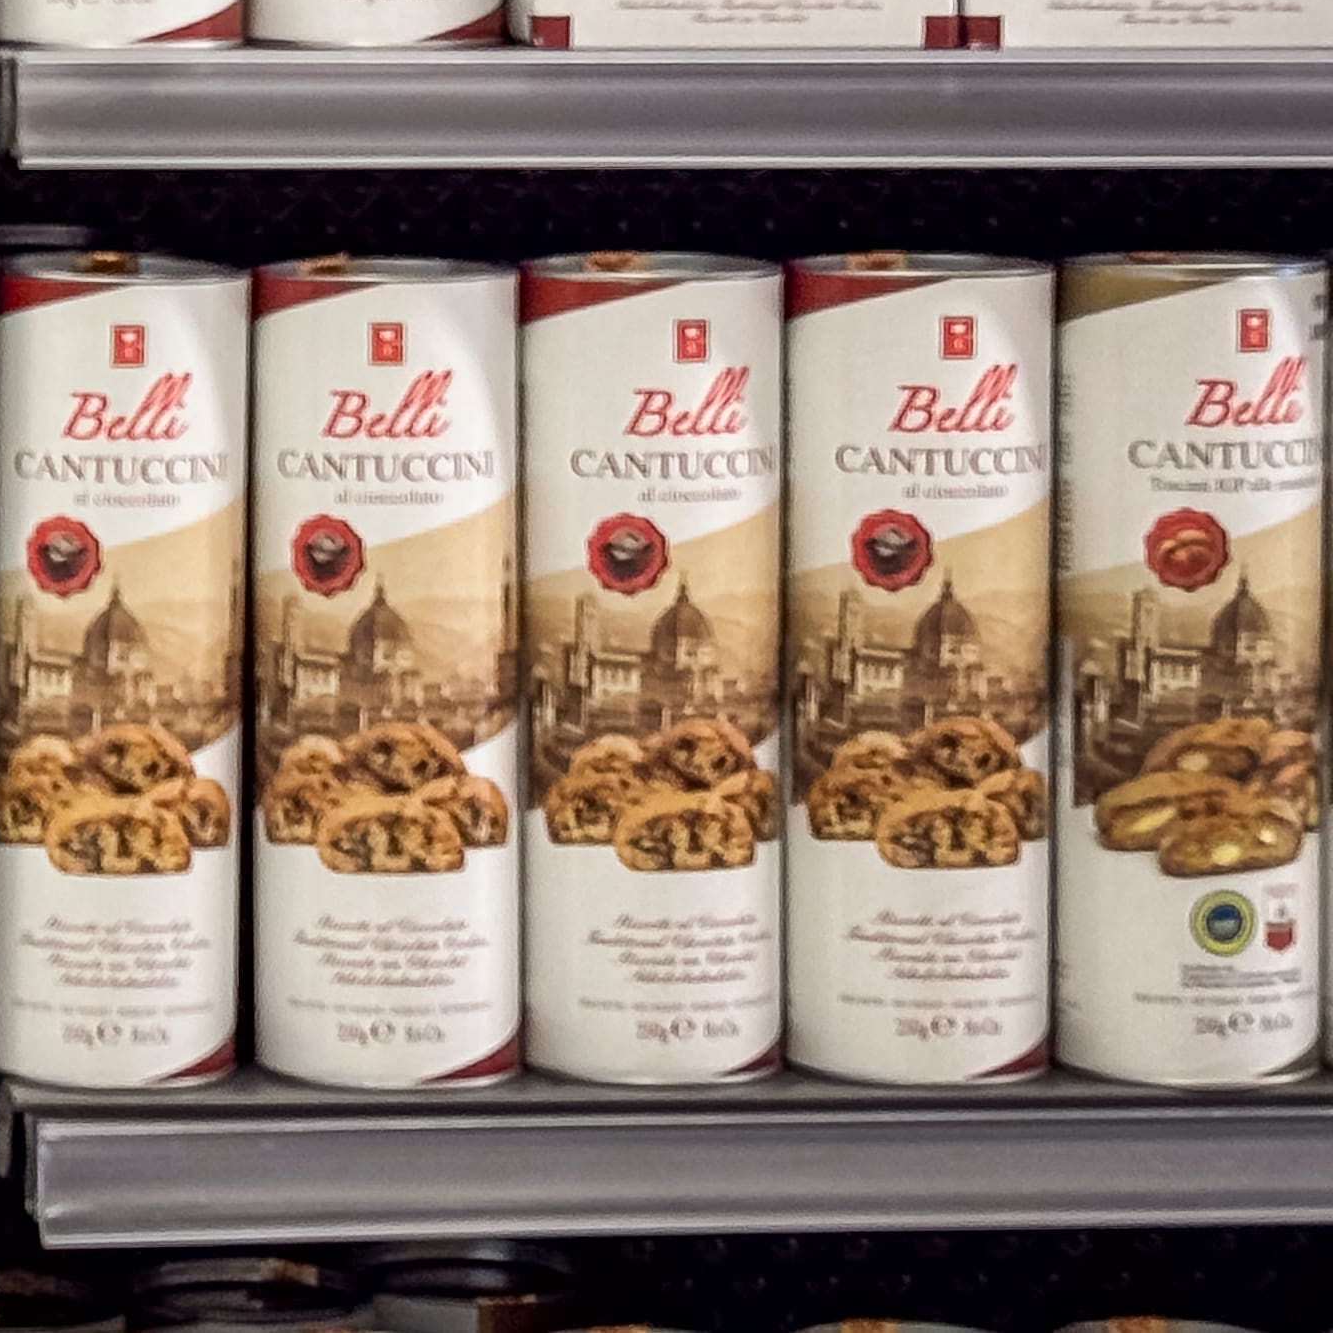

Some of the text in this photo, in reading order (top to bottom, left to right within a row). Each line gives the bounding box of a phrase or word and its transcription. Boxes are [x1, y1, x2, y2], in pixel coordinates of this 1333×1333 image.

[61, 371, 193, 442] Belli
[321, 369, 455, 440] Belli
[623, 365, 751, 437] Belli
[887, 363, 1018, 433] Belli
[1184, 356, 1307, 428] Belli
[13, 449, 229, 485] CANTUCCINI
[277, 447, 495, 483] CANTUCCINI
